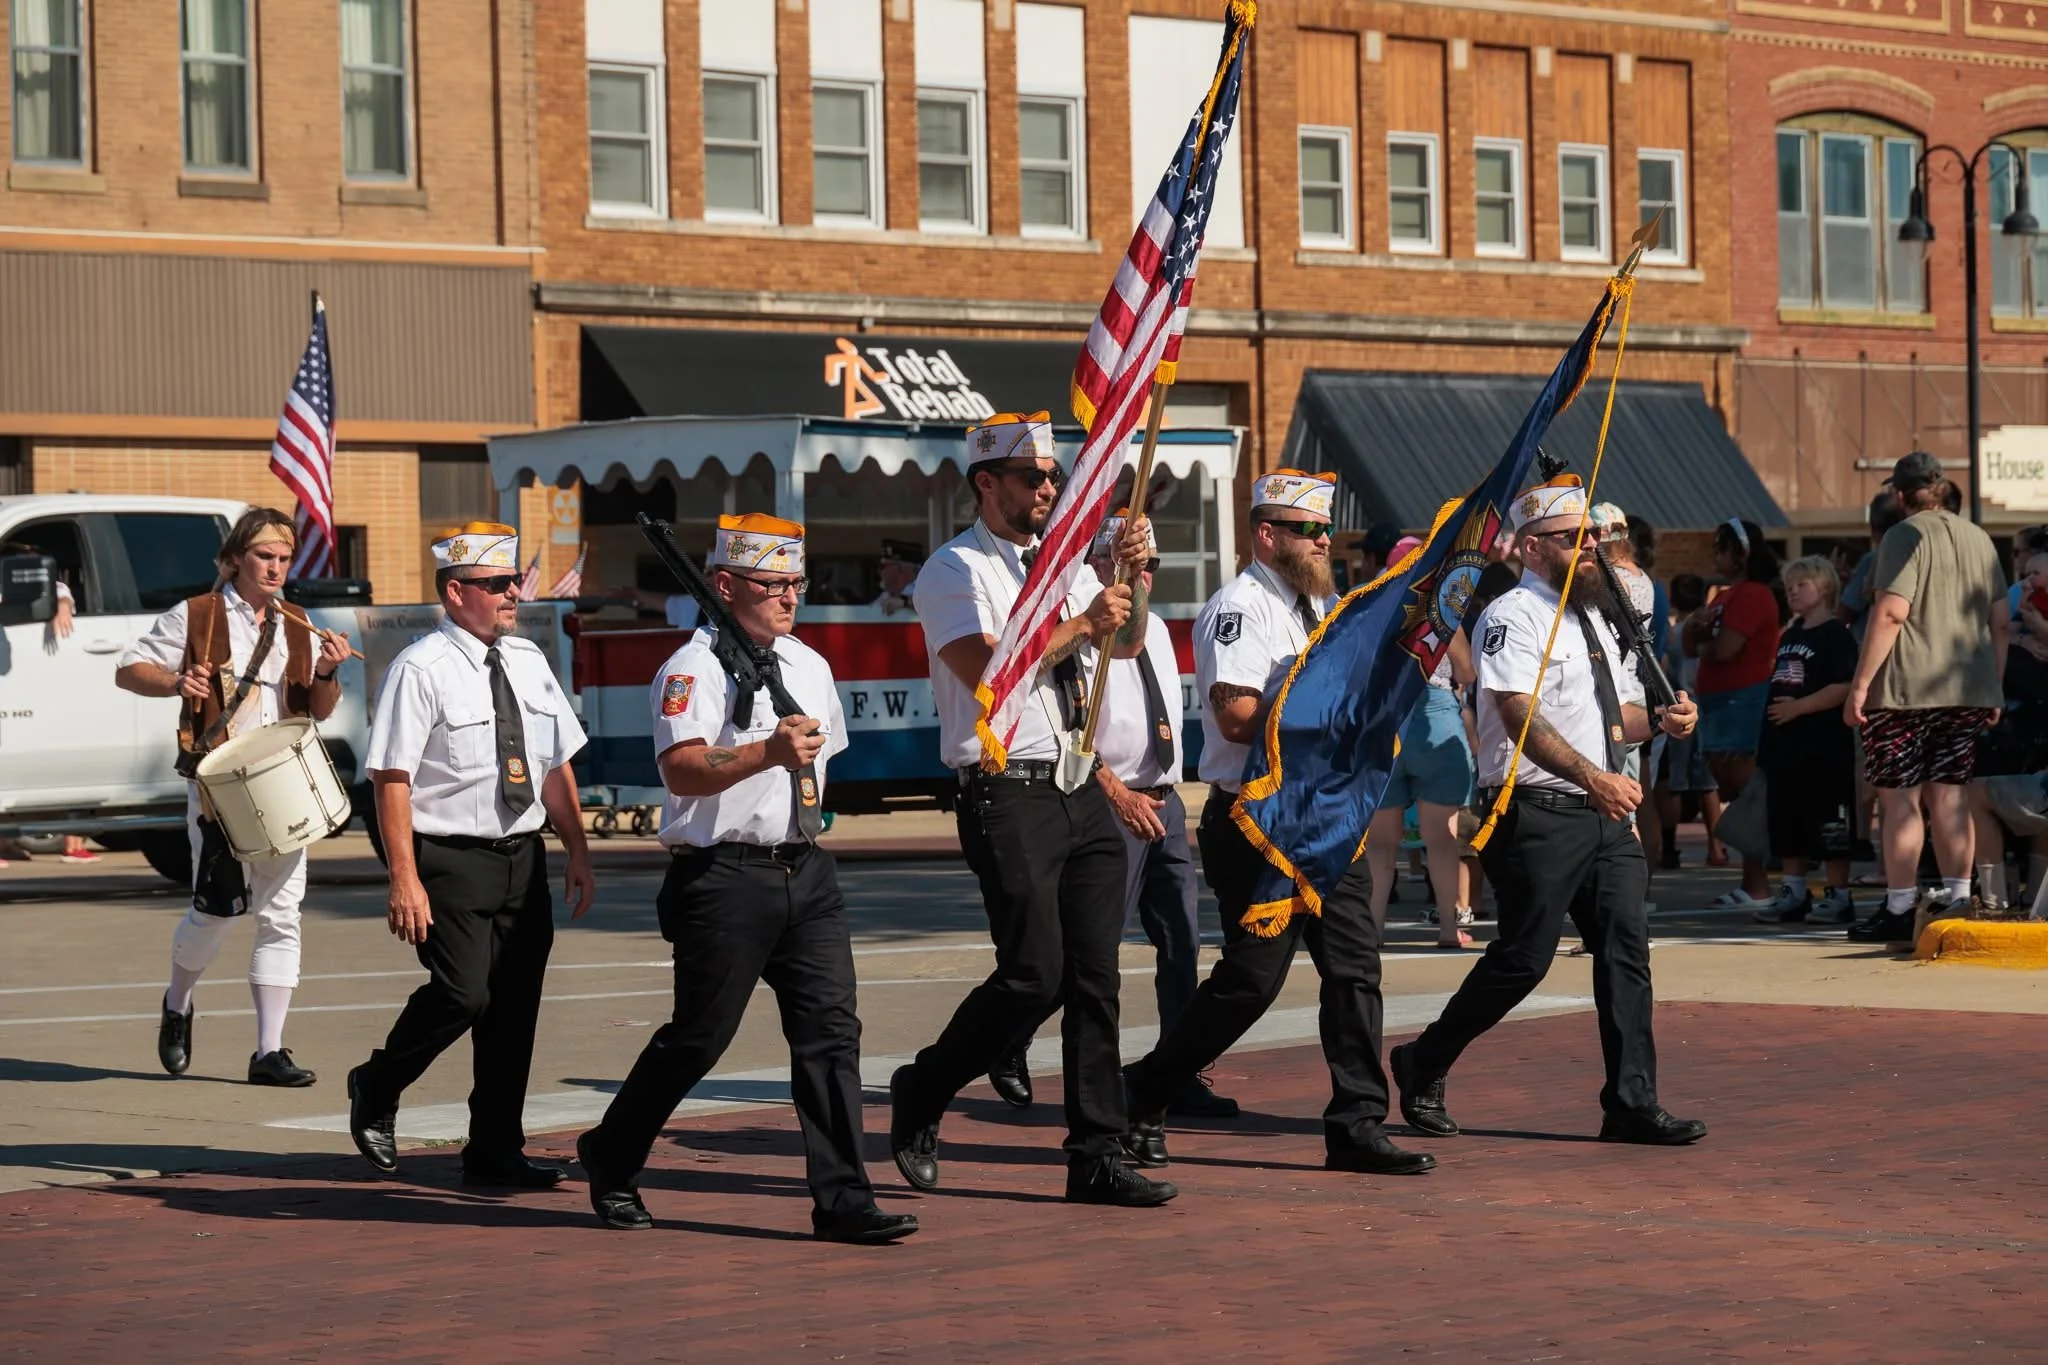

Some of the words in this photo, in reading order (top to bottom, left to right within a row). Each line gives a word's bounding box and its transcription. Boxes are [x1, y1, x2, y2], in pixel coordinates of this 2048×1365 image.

[865, 347, 971, 385] Total
[880, 383, 997, 420] Rehab
[1986, 451, 2044, 480] House
[366, 615, 396, 629] Iowa
